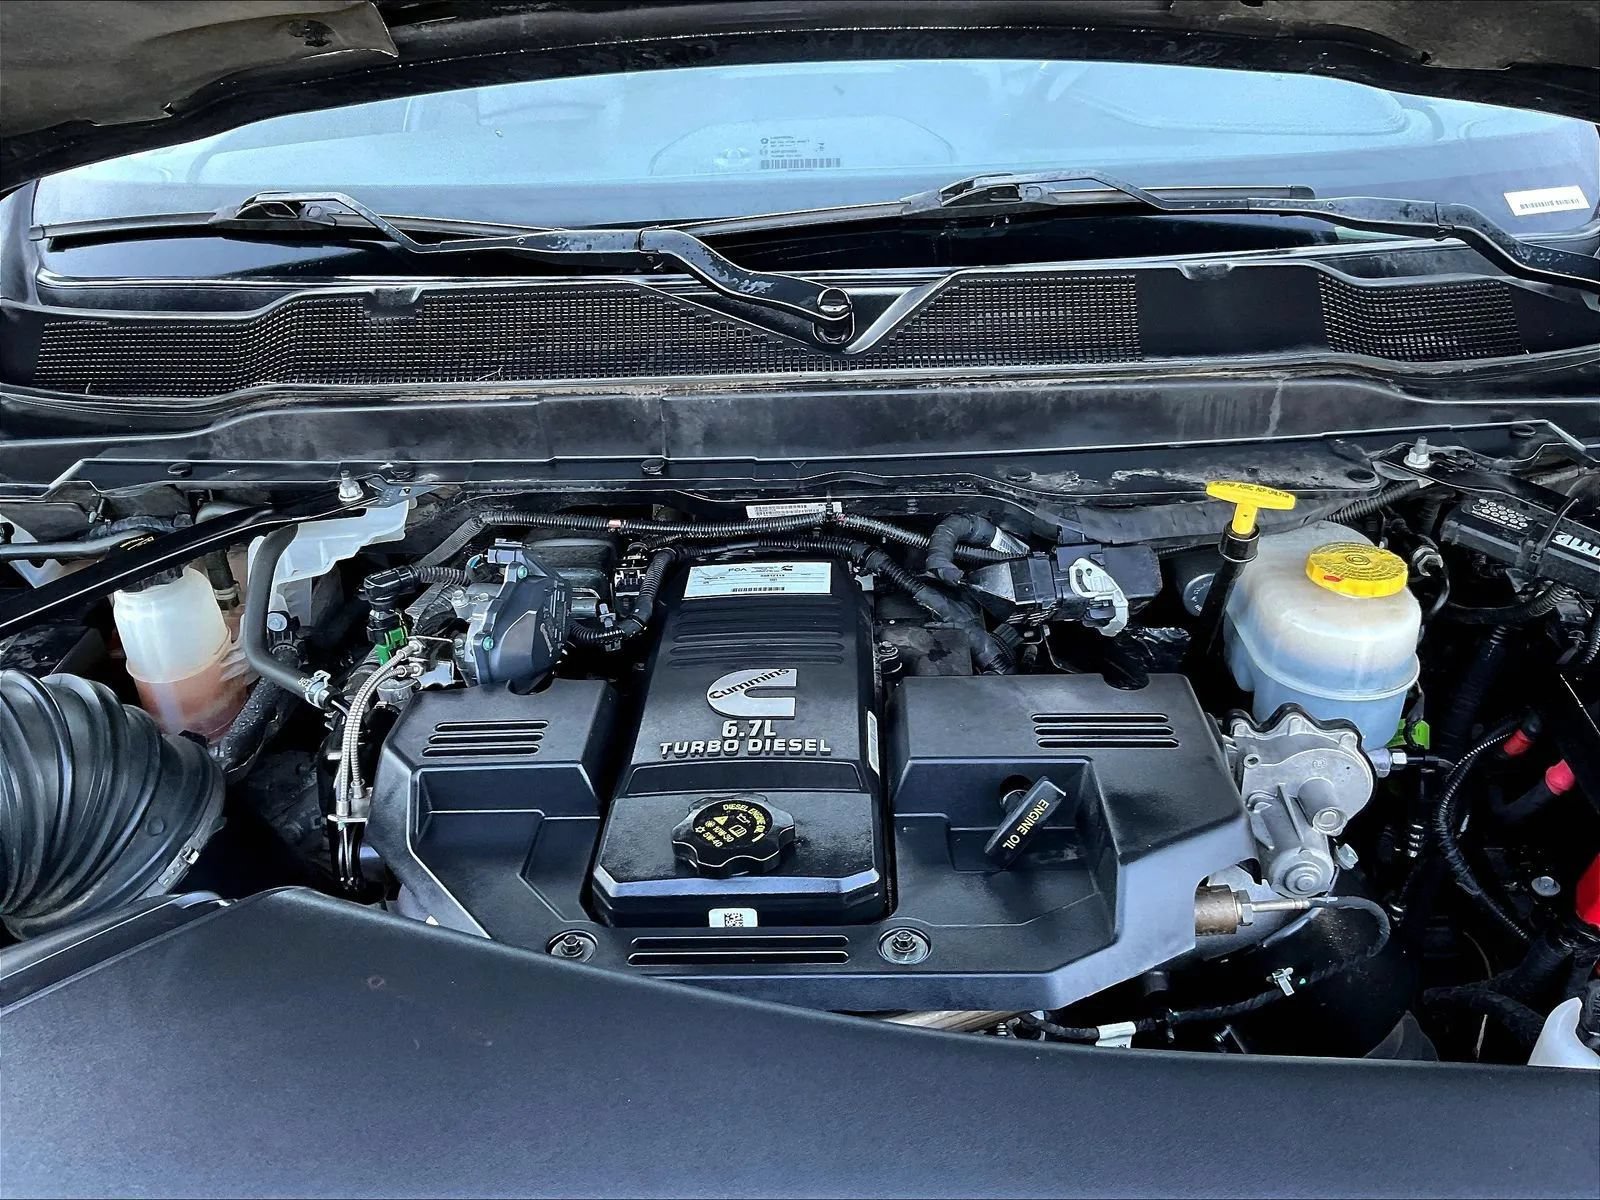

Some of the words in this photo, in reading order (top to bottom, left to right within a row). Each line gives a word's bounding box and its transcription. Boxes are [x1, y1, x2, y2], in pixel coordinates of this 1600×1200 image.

[708, 668, 790, 700] Cummins
[721, 719, 777, 740] 6.7L
[659, 739, 740, 757] TURBO
[747, 738, 832, 755] DIESEL
[722, 803, 749, 812] DIESEL
[1017, 799, 1049, 835] ENGINE
[1002, 835, 1020, 849] OIL
